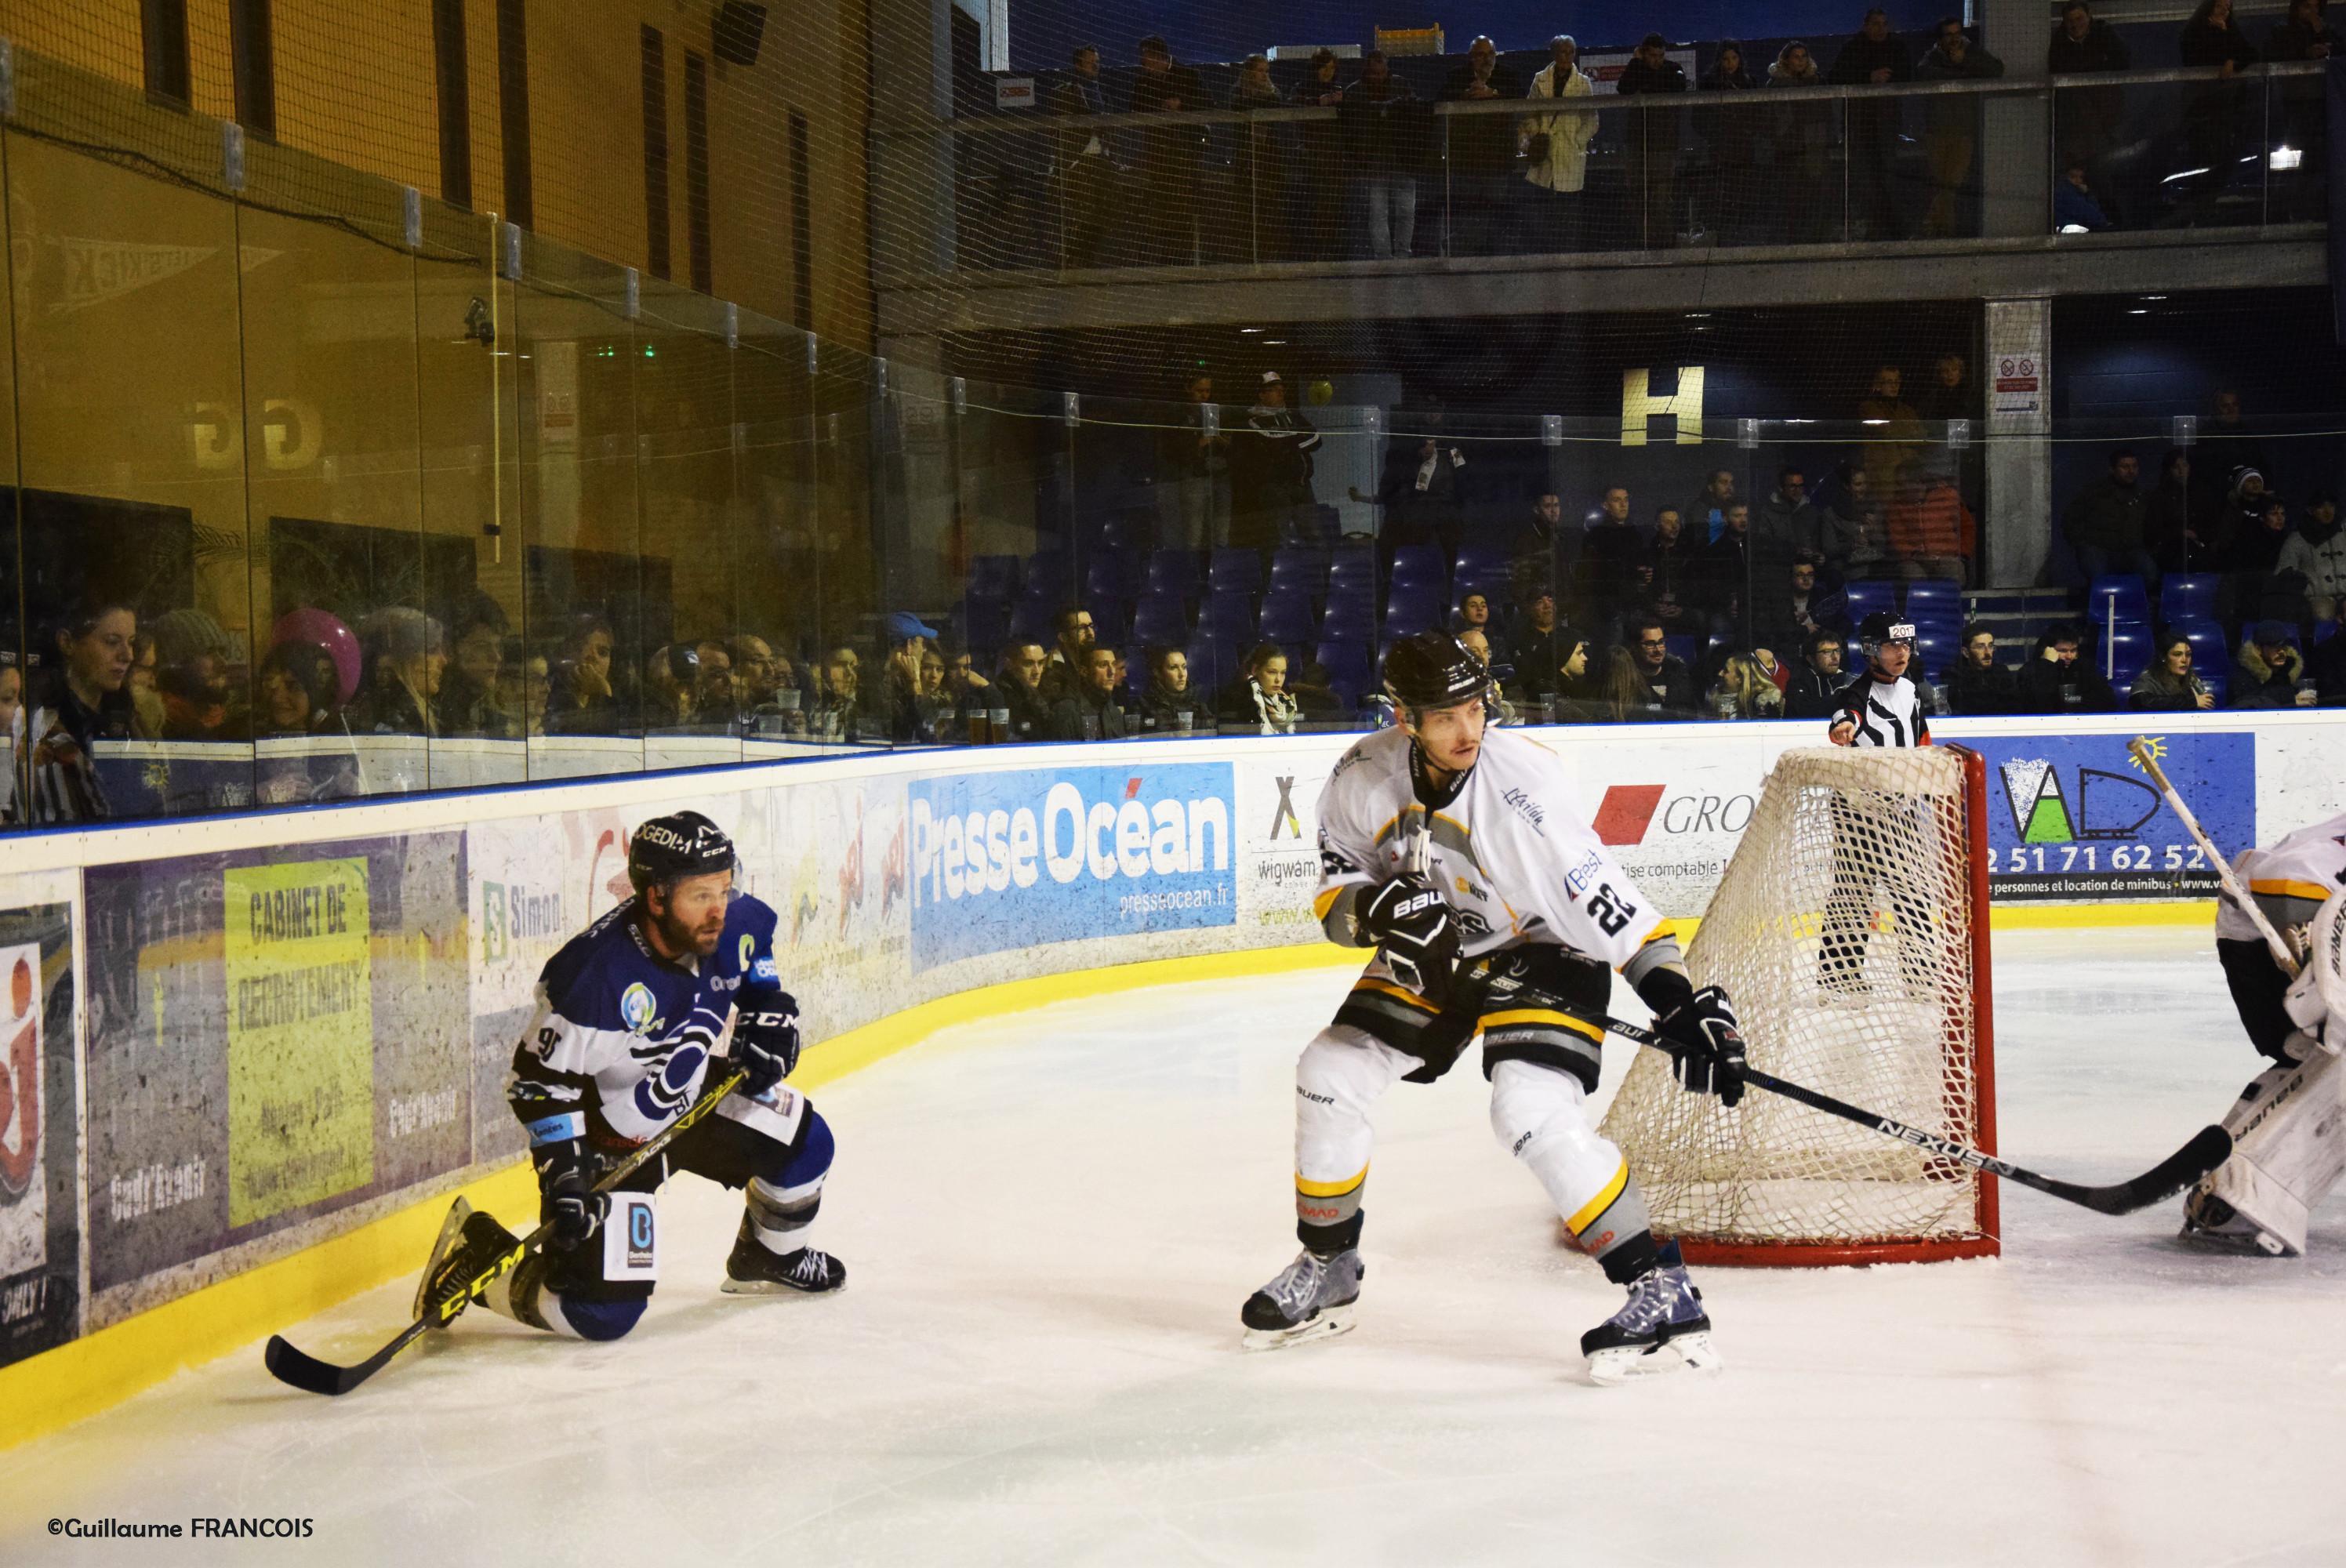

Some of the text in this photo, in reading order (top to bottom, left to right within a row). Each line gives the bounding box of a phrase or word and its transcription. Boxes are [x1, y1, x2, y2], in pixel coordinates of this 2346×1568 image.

[1621, 366, 1704, 446] H
[1893, 626, 1914, 637] 2017
[1663, 794, 1756, 834] GRO
[634, 823, 692, 855] OGEDIM
[702, 845, 728, 858] CCM
[913, 778, 1228, 907] Presse Océan
[1258, 858, 1316, 886] wigwam
[1568, 848, 1603, 891] Best
[1648, 860, 1718, 879] comptable
[2010, 848, 2044, 872] 51
[2061, 847, 2096, 871] 71
[2112, 845, 2152, 870] 62
[2164, 844, 2205, 869] 52
[1120, 882, 1228, 920] presseocean.fr
[1995, 883, 2050, 895] personnes
[2051, 880, 2062, 891] et
[2065, 880, 2108, 891] location
[2112, 879, 2125, 890] de
[2127, 878, 2171, 890] minibus
[251, 884, 347, 946] CABINET DE
[511, 884, 561, 939] Simon
[1393, 891, 1445, 920] BAU
[1587, 883, 1637, 938] 22
[735, 1012, 799, 1029] CCM
[1487, 1031, 1534, 1046] AUER
[1296, 1085, 1335, 1105] AUER
[1877, 1118, 1987, 1167] NEXUS
[440, 1242, 525, 1321] CCM
